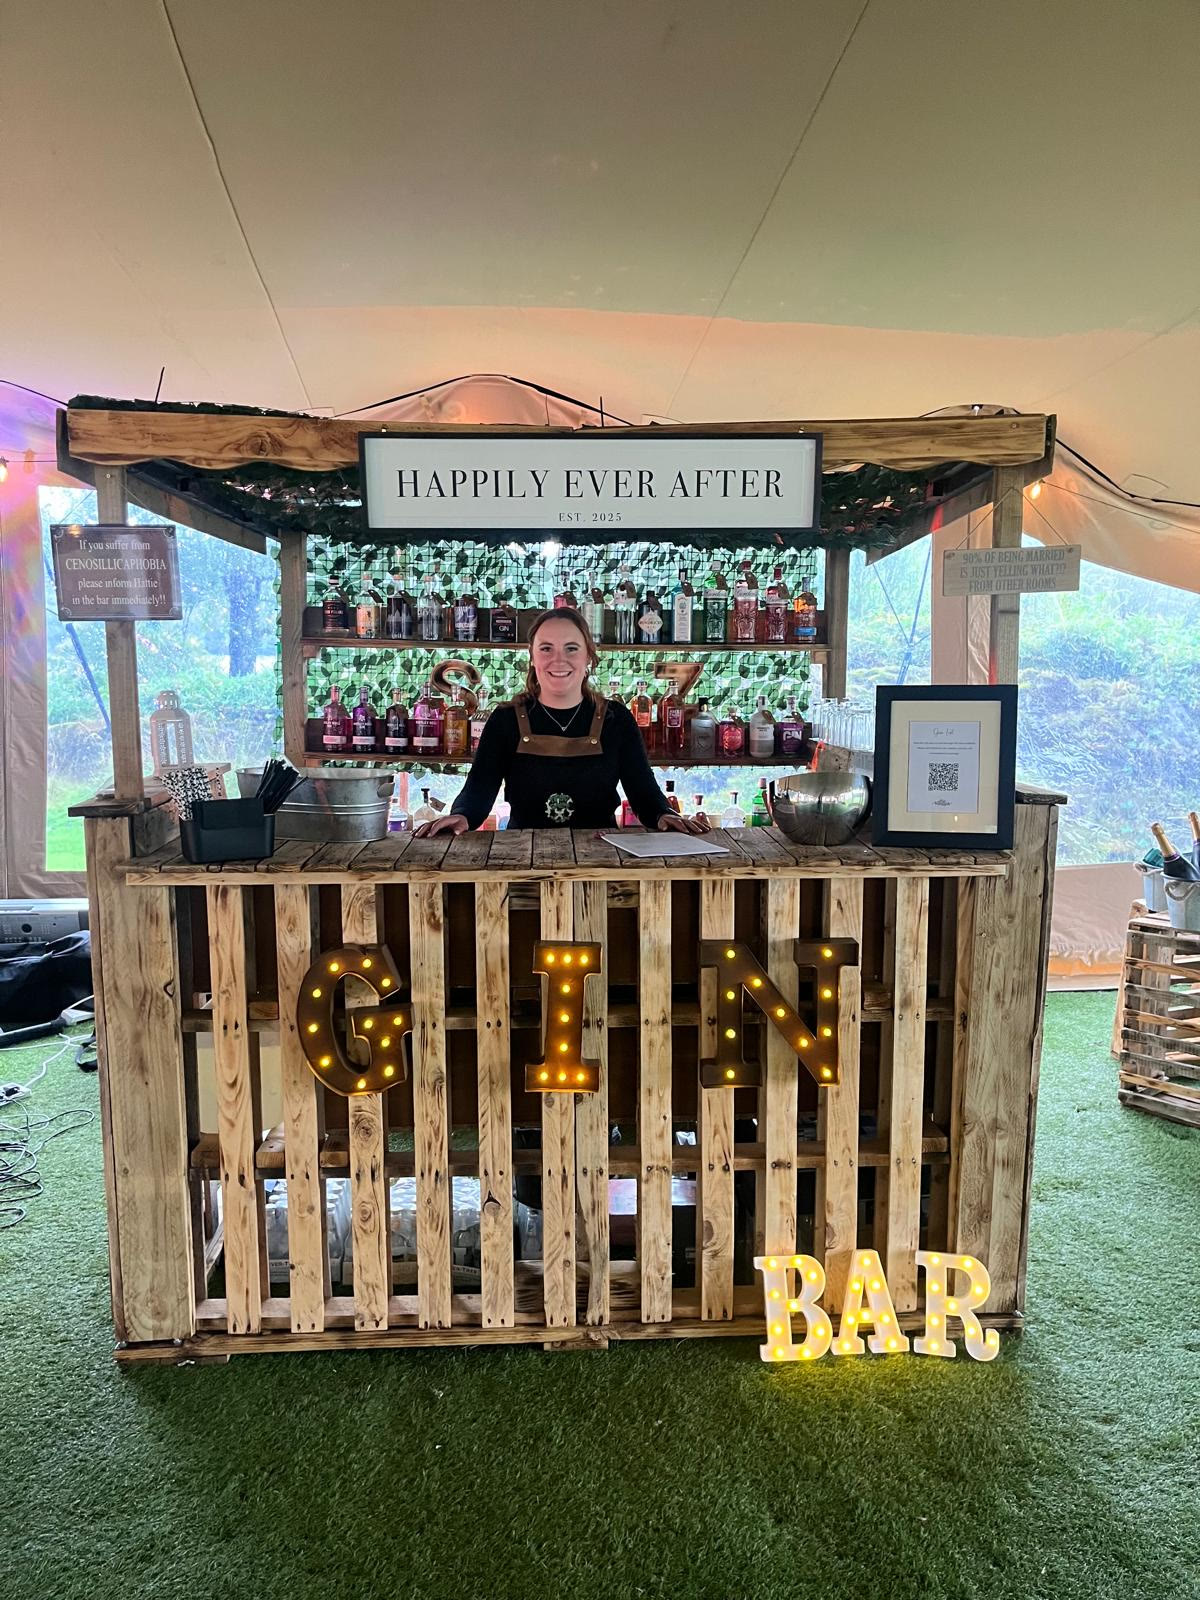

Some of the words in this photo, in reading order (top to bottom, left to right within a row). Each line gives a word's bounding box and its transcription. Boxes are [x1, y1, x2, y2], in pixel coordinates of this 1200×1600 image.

[397, 469, 550, 498] HAPPILY
[564, 469, 657, 498] EVER
[669, 469, 784, 498] AFTER
[558, 512, 587, 522] EST.
[592, 512, 622, 522] 2025
[79, 539, 87, 550] If
[88, 541, 103, 552] you
[106, 539, 128, 550] suffer
[131, 539, 150, 550] from
[962, 553, 983, 564] 90%
[985, 552, 996, 564] OF
[998, 551, 1023, 563] BEING
[1026, 549, 1065, 562] MARRIED
[65, 558, 167, 570] CENOSILLICAPHOBIA
[960, 567, 968, 578] IS
[970, 566, 991, 578] JUST
[993, 565, 1028, 577] YELLING
[78, 578, 103, 590] please
[105, 578, 132, 588] inform
[969, 580, 993, 592] FROM
[995, 579, 1024, 591] OTHER
[1026, 578, 1056, 590] ROOMS
[72, 595, 80, 605] in
[82, 594, 95, 605] the
[97, 594, 109, 605] bar
[112, 594, 166, 607] immediately!!
[296, 937, 860, 1097] GIN
[753, 1249, 1000, 1362] BAR
